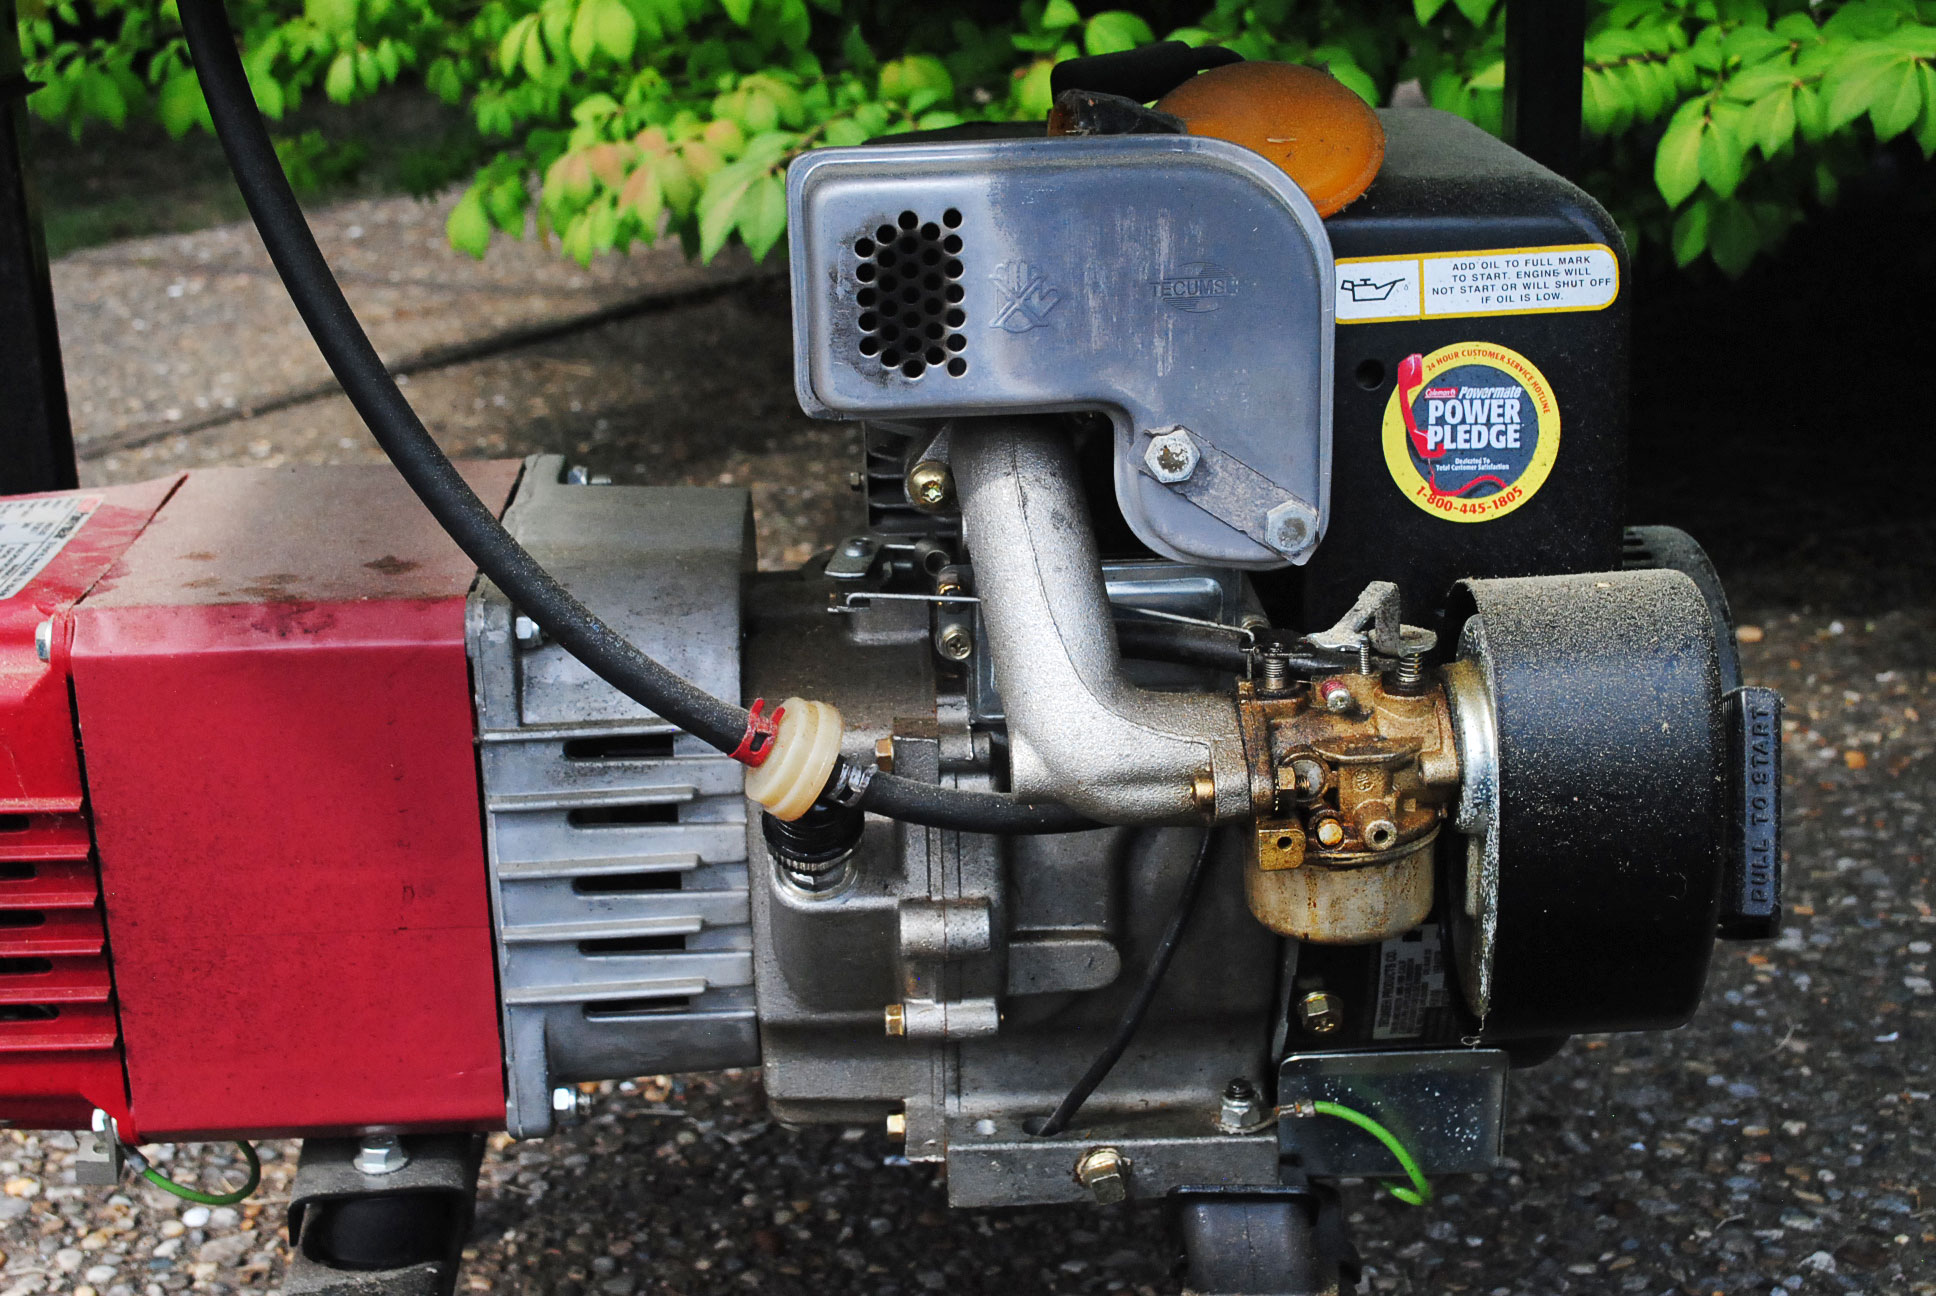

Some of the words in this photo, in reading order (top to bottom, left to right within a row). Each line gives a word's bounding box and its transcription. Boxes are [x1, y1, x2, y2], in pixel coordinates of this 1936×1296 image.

[1452, 262, 1476, 271] ADD
[1481, 261, 1500, 270] OIL
[1505, 259, 1519, 268] TO
[1524, 258, 1553, 267] FULL
[1558, 256, 1591, 265] MARK
[1452, 274, 1467, 282] TO
[1472, 271, 1511, 282] START.
[1516, 269, 1560, 279] ENGINE
[1564, 267, 1592, 276] WILL
[1432, 286, 1454, 295] NOT
[1460, 284, 1496, 294] START
[1501, 283, 1517, 292] OR
[1522, 281, 1550, 290] WILL
[1555, 279, 1584, 289] SHUT
[1589, 278, 1611, 287] OFF
[1481, 296, 1492, 304] IF
[1496, 294, 1515, 304] OIL
[1520, 293, 1531, 302] IS
[1536, 292, 1564, 301] LOW.
[1426, 362, 1436, 372] 24
[1436, 351, 1459, 366] HOUR
[1461, 349, 1506, 362] CUSTOMER
[1506, 357, 1534, 382] SERVICE
[1531, 380, 1551, 415] HOTLINE
[1458, 385, 1521, 399] Powermate
[1428, 399, 1521, 425] POWER
[1427, 424, 1521, 450] PLEDGE
[1416, 485, 1523, 515] 1-800-445-1805
[1751, 708, 1770, 785] START
[1751, 797, 1770, 826] TO
[1751, 838, 1770, 903] PULL
